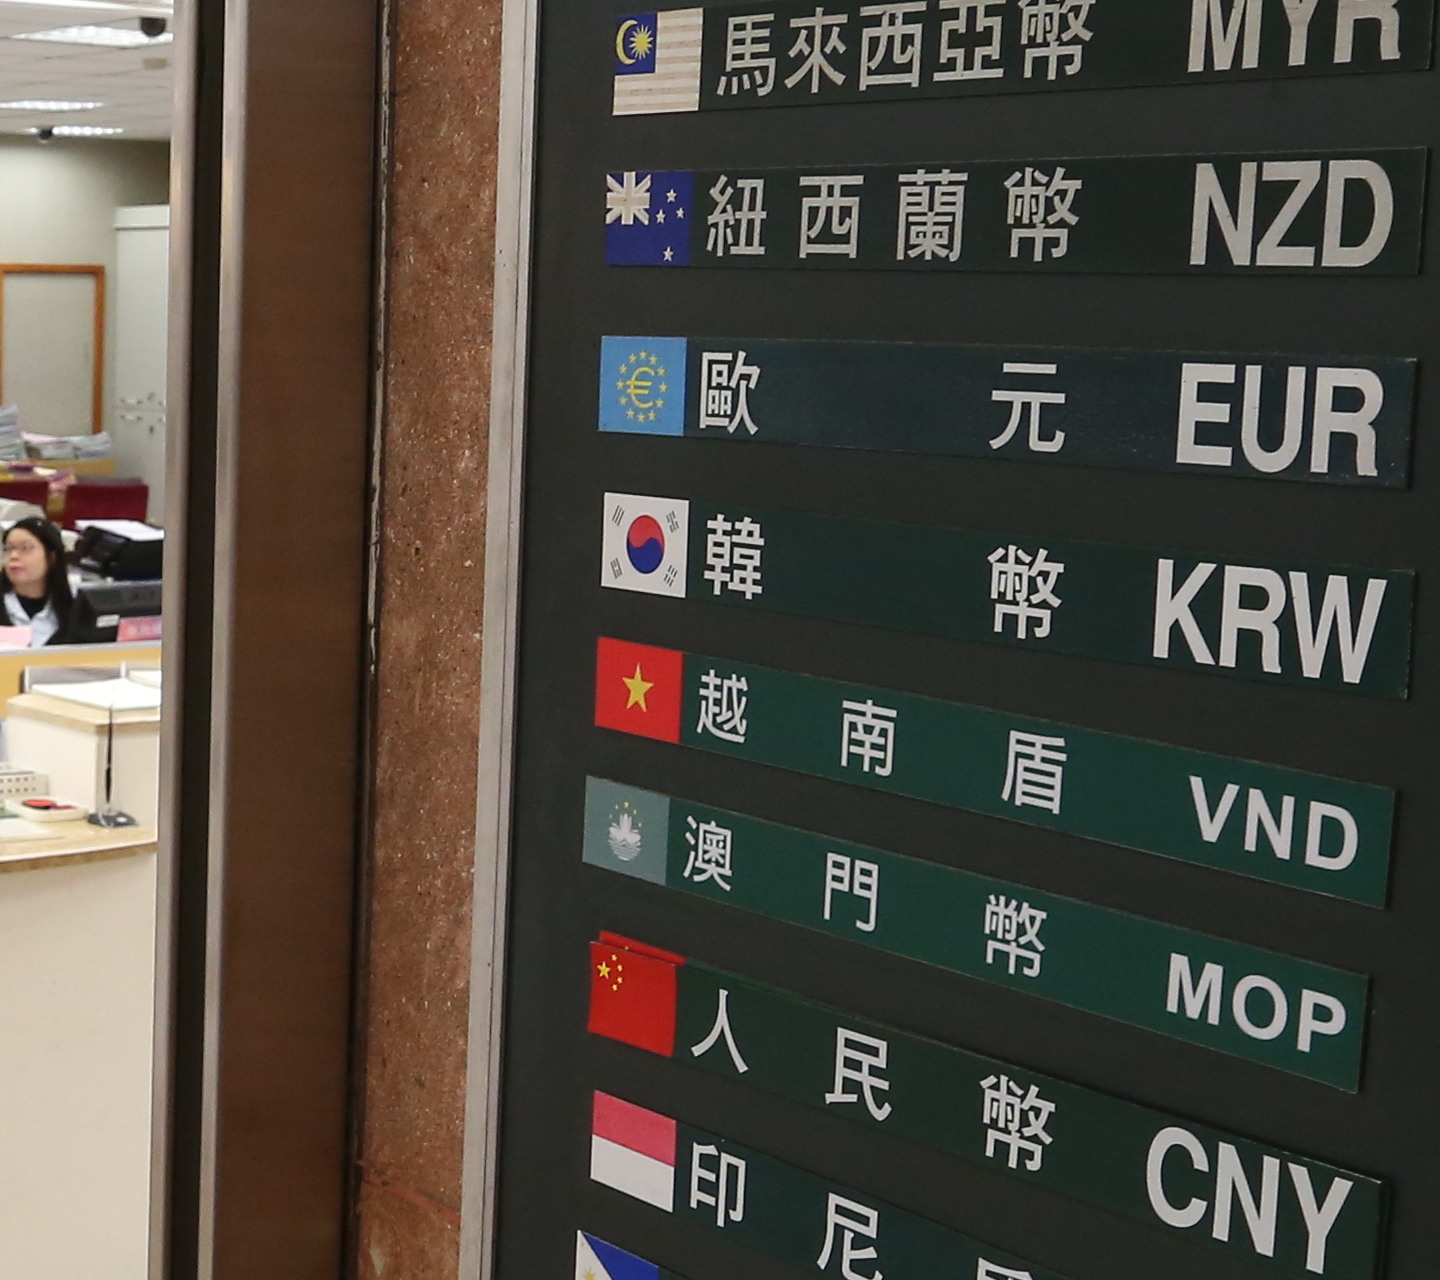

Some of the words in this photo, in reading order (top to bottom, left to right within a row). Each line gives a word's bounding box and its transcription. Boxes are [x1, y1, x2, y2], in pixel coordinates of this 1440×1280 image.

[706, 165, 1082, 263] 紐西蘭幣
[1189, 158, 1393, 268] NZD
[1175, 362, 1384, 478] EUR
[1152, 559, 1388, 686] KRW
[697, 668, 1068, 815] 越南盾
[1188, 774, 1360, 872] VND
[682, 815, 1047, 978] 澳門幣
[1167, 954, 1347, 1053] MOP
[690, 989, 1056, 1172] 人民幣
[1146, 1126, 1354, 1275] CNY
